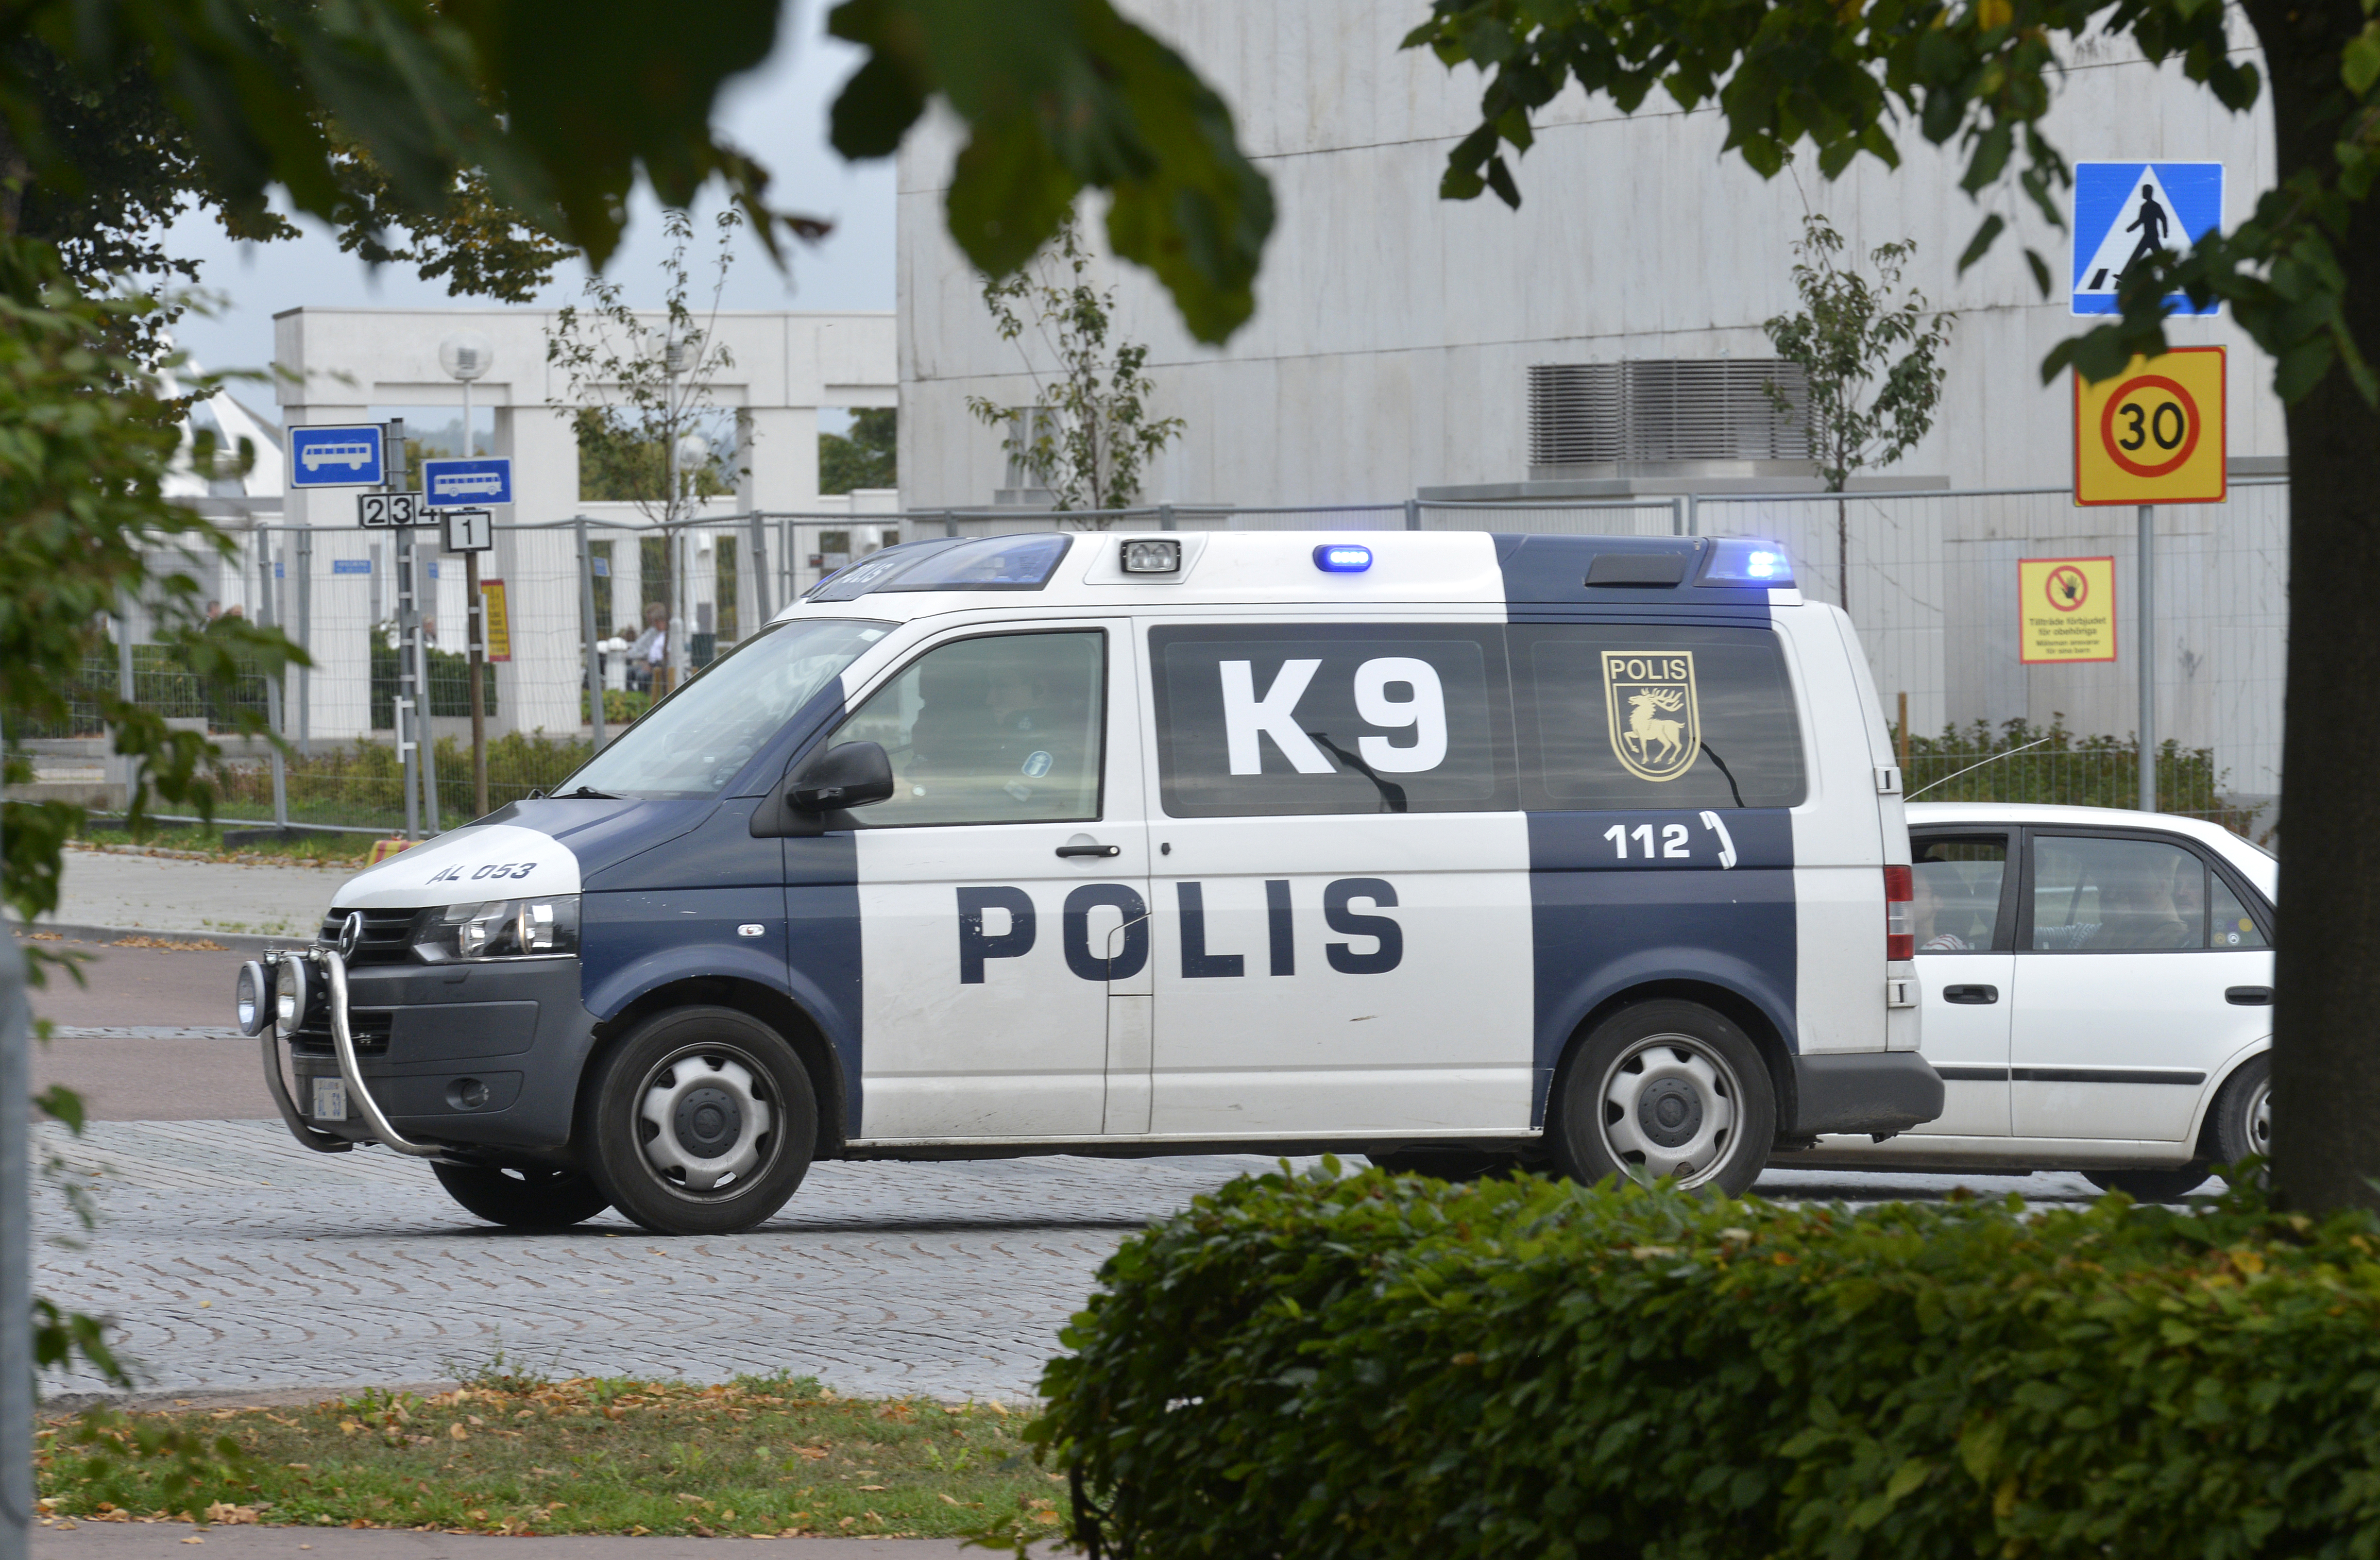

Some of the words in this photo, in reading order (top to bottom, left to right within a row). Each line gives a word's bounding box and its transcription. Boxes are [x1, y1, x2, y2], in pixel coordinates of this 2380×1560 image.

[2119, 401, 2184, 451] 30
[463, 519, 471, 545] 1
[1609, 659, 1687, 680] POLIS
[1219, 657, 1448, 775] K9
[1604, 824, 1690, 858] 112
[471, 862, 538, 879] 053
[956, 877, 1404, 985] POLIS
